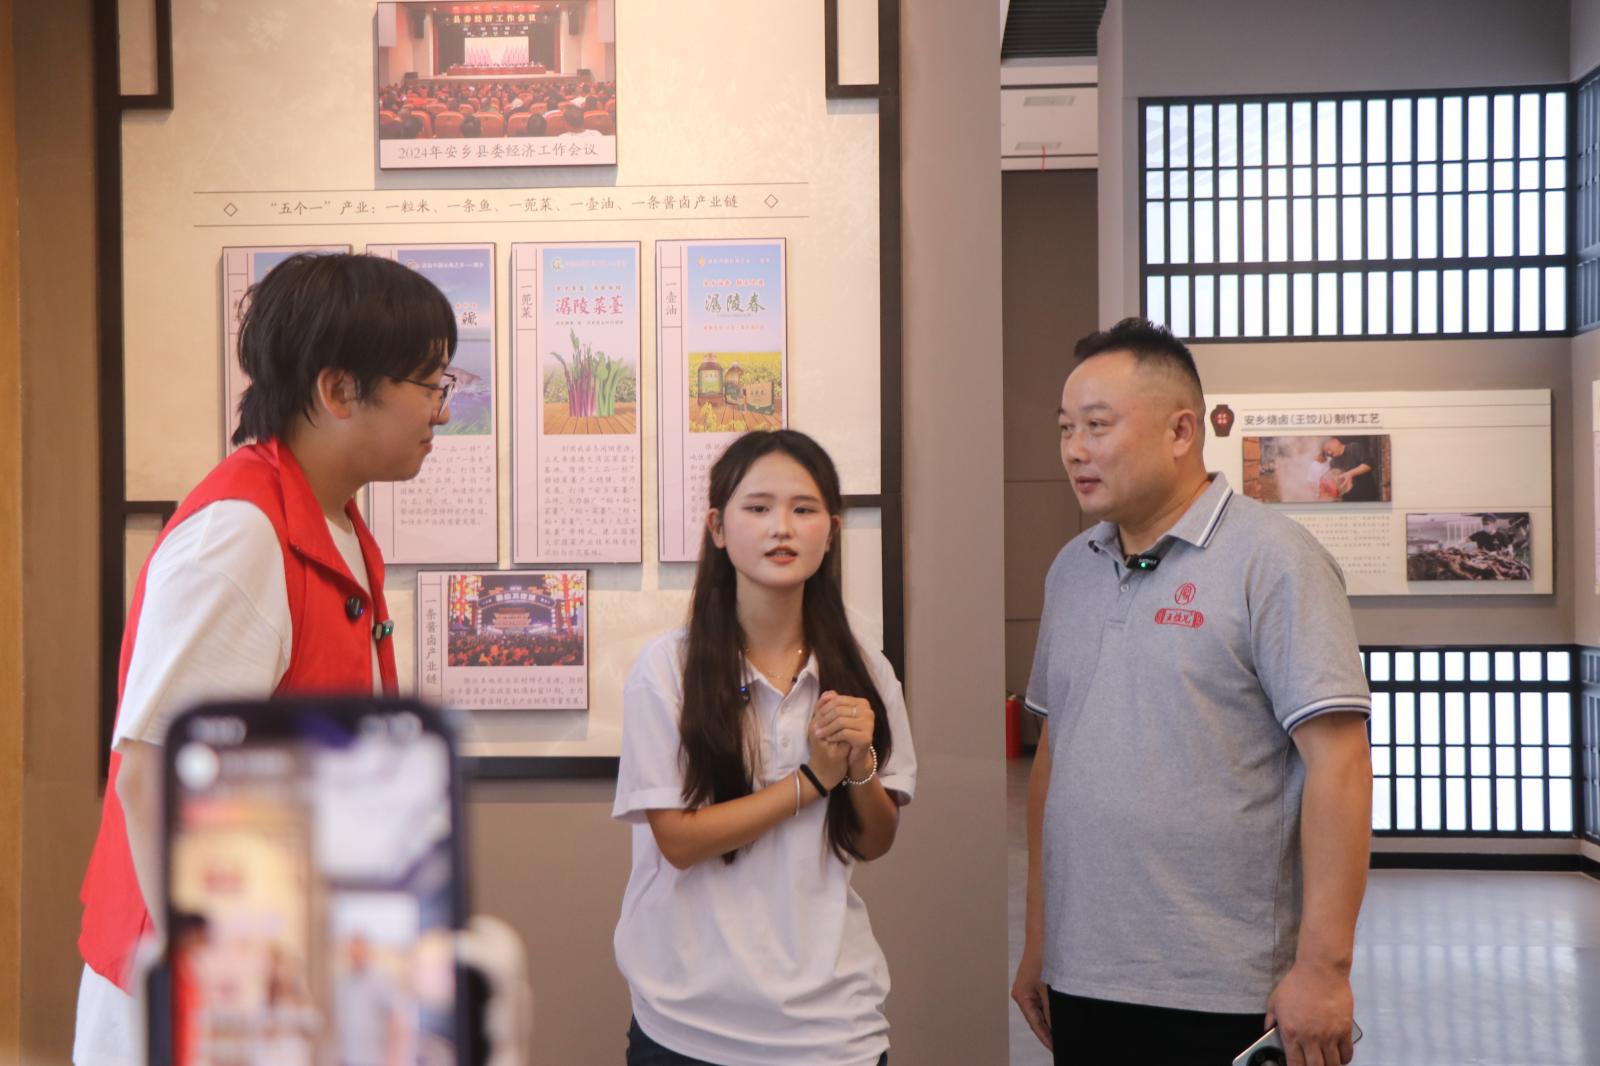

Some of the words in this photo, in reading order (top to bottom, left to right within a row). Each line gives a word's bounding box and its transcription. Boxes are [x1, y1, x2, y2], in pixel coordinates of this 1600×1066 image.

[398, 142, 598, 160] 2024年安乡县委经济工作会议
